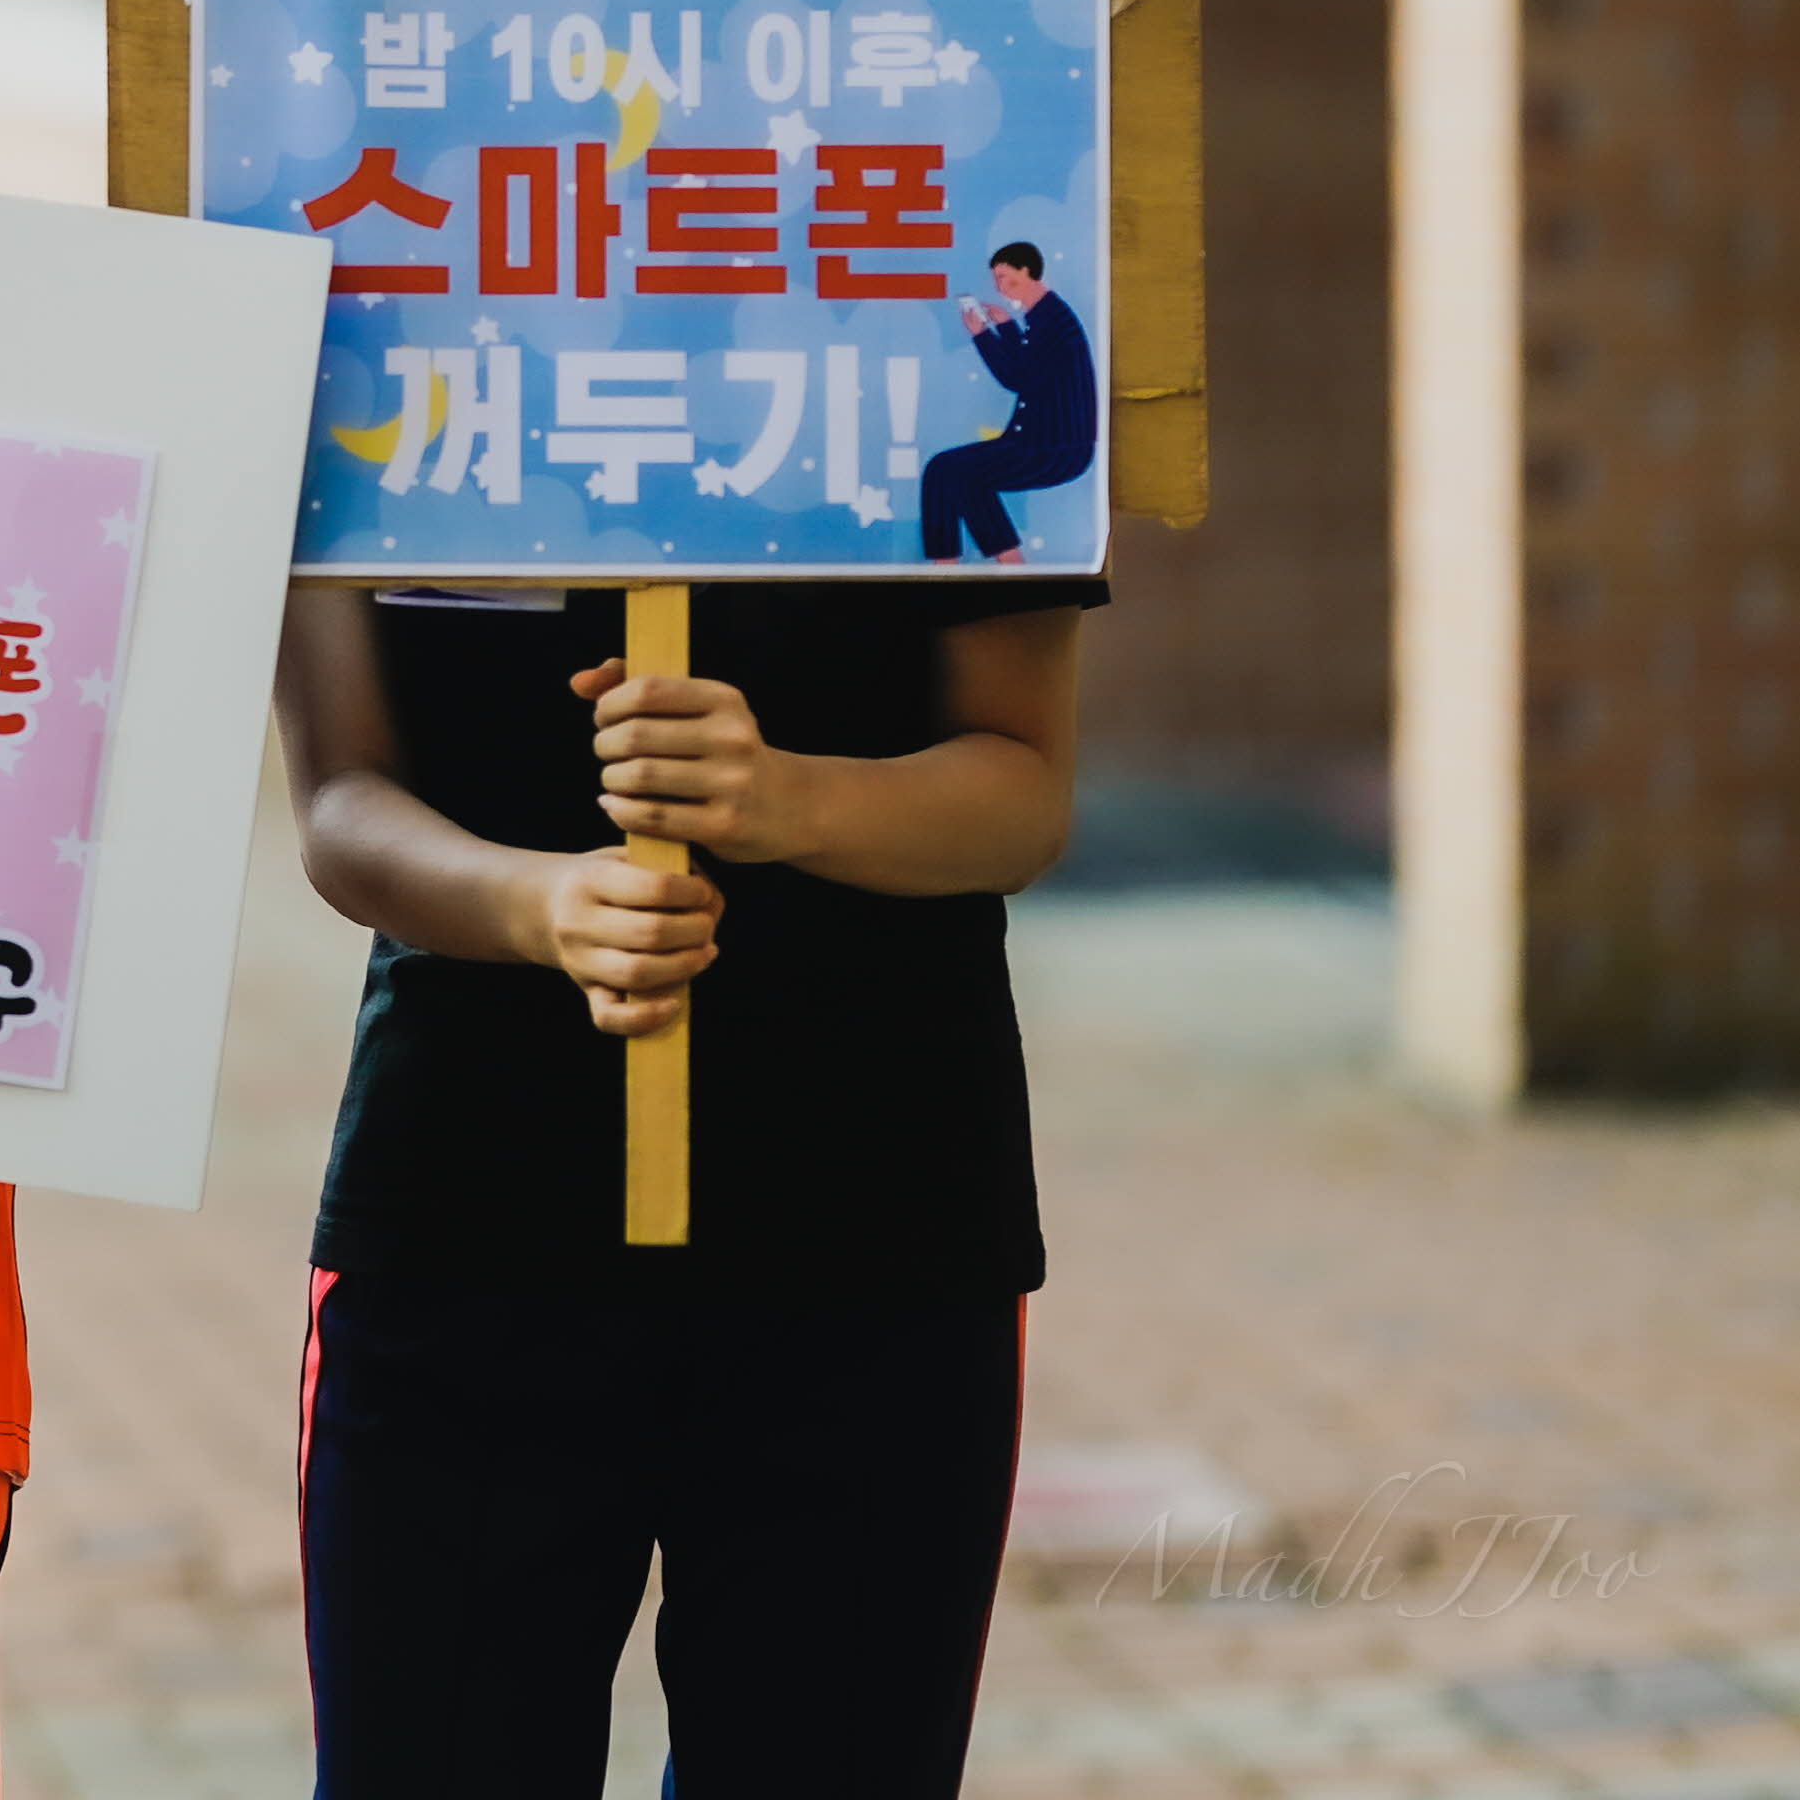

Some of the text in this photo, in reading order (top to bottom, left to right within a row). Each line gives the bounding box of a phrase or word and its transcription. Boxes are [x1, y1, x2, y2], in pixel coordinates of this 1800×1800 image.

[362, 9, 940, 110] 밤 10시 이후
[302, 142, 955, 301] 스마트폰
[378, 343, 922, 508] 꺼두기!
